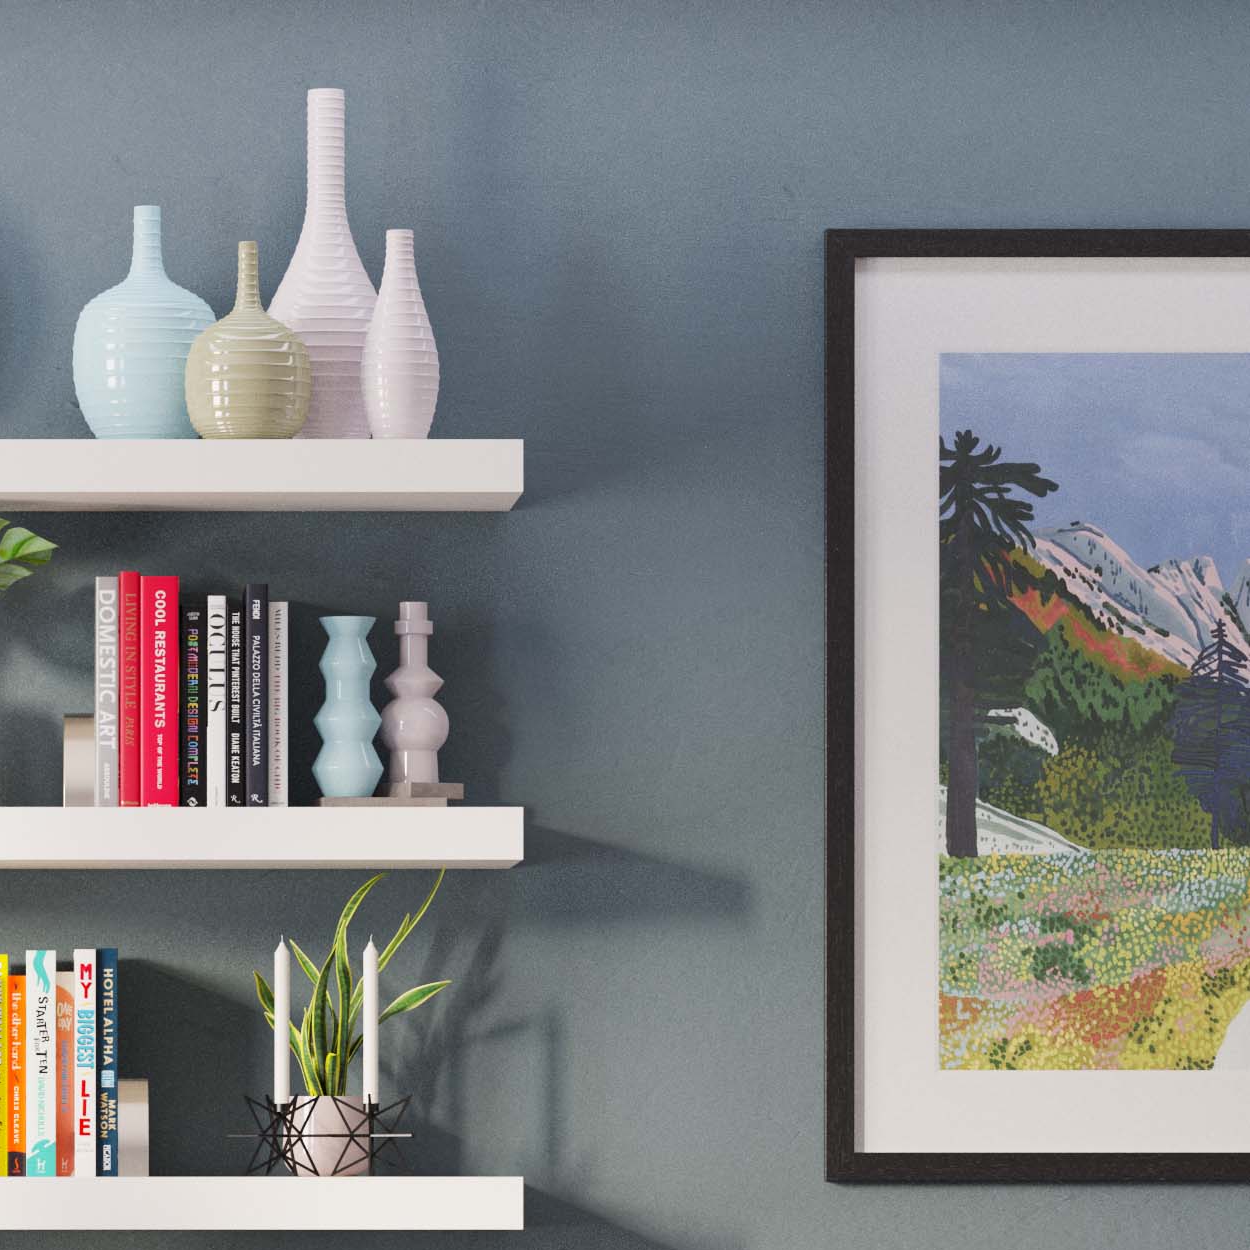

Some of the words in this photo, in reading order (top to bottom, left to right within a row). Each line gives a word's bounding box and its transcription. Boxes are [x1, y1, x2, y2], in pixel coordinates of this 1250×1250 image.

[125, 593, 137, 641] LIVING
[154, 590, 166, 626] COOL
[231, 612, 241, 624] THE
[252, 599, 261, 620] FENDI
[99, 590, 116, 703] DOMESTIC
[125, 645, 137, 662] IN
[231, 625, 241, 648] HOUSE
[252, 635, 261, 671] PALAZZO
[208, 613, 227, 712] OCULUS
[231, 649, 241, 665] THAT
[125, 665, 137, 709] STYLE
[154, 630, 166, 728] RESTAURANTS
[231, 666, 241, 703] PINTEREST
[252, 672, 261, 698] DELLA
[99, 711, 116, 749] ART
[187, 696, 199, 733] DESIGN
[231, 704, 241, 724] BUILT
[252, 698, 263, 728] CIVILTÀ
[125, 716, 135, 747] PARIS
[231, 732, 241, 754] DIANE
[252, 729, 261, 767] ITALIANA
[156, 746, 163, 755] OF
[187, 735, 199, 786] COMPLETE
[231, 755, 241, 783] KEATON
[80, 963, 93, 999] MY
[103, 968, 114, 1014] HOTEL
[12, 992, 22, 1011] the
[36, 996, 50, 1043] STARTER
[12, 1013, 22, 1040] other
[77, 1010, 95, 1069] BIGGEST
[103, 1018, 114, 1066] ALPHA
[12, 1042, 22, 1070] hand
[36, 1050, 50, 1074] TEN
[79, 1079, 91, 1136] LIE
[100, 1092, 109, 1138] WATSON
[108, 1099, 117, 1130] MARK
